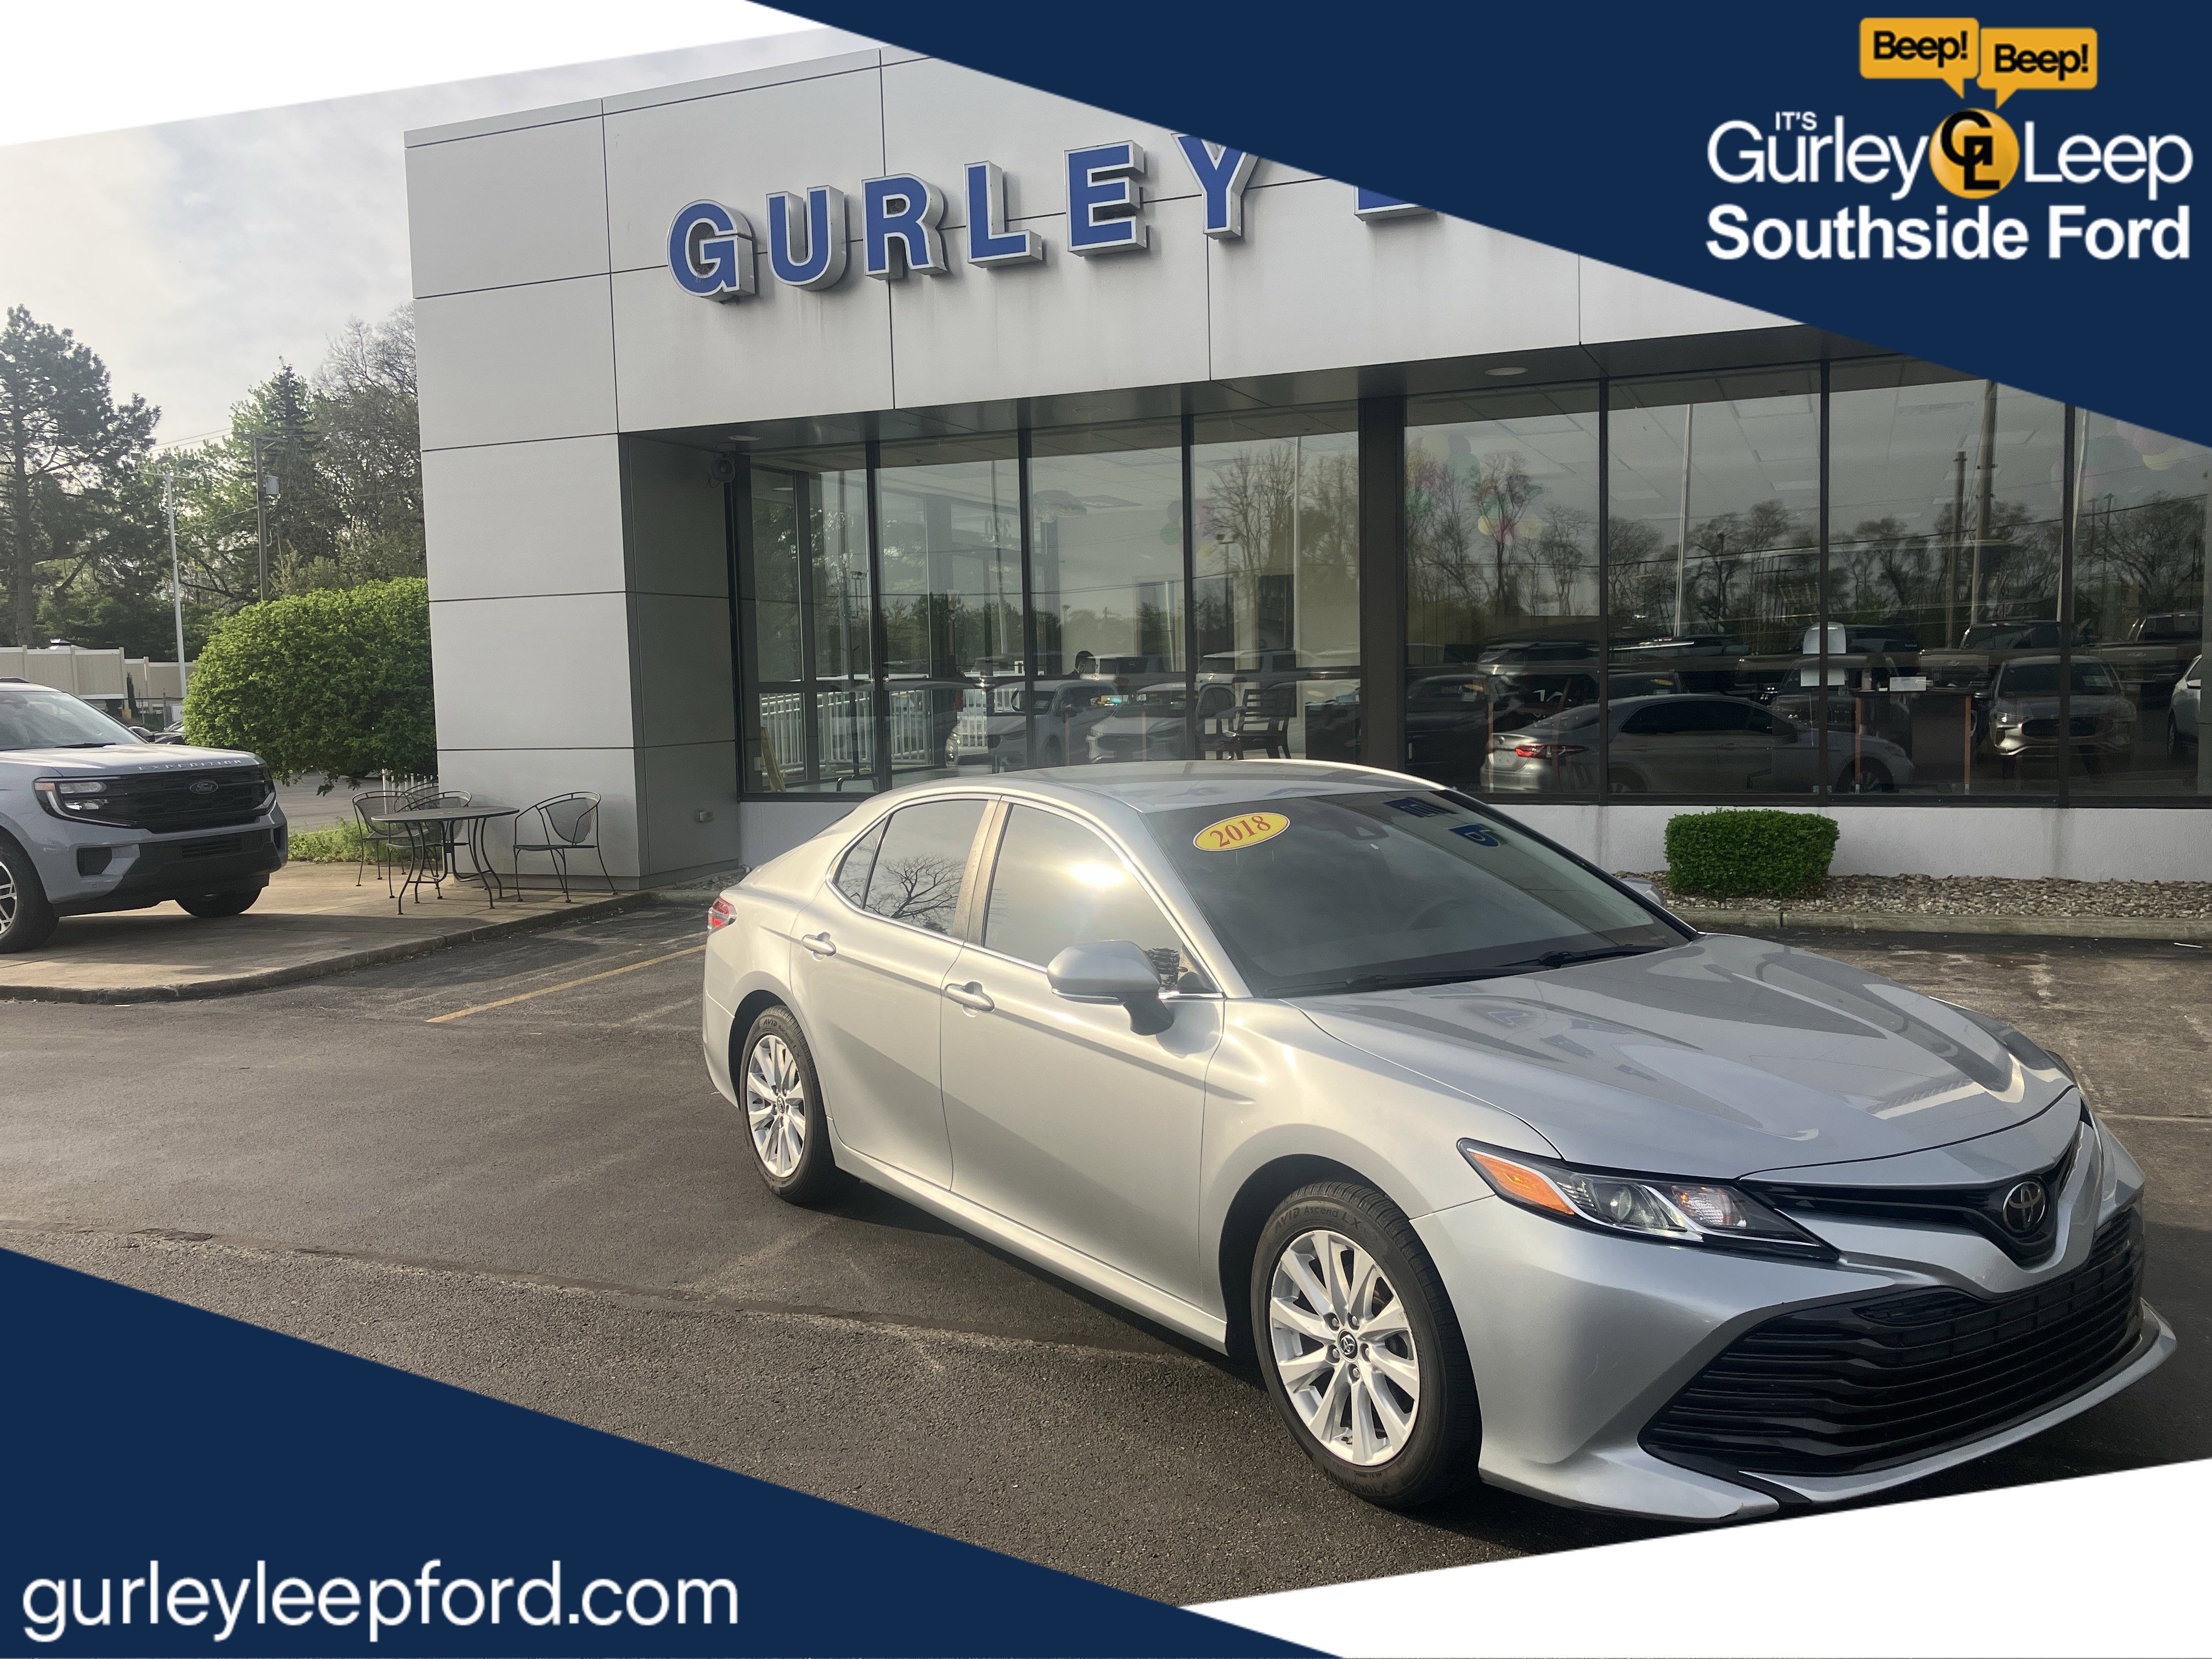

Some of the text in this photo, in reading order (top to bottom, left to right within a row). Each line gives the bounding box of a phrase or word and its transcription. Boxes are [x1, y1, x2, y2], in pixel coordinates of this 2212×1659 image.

[667, 133, 1257, 301] GURLEY
[138, 760, 242, 771] EXPEDITION
[1210, 815, 1271, 848] 2018
[1274, 1207, 1300, 1233] AVID
[1303, 1206, 1339, 1218] Ascend
